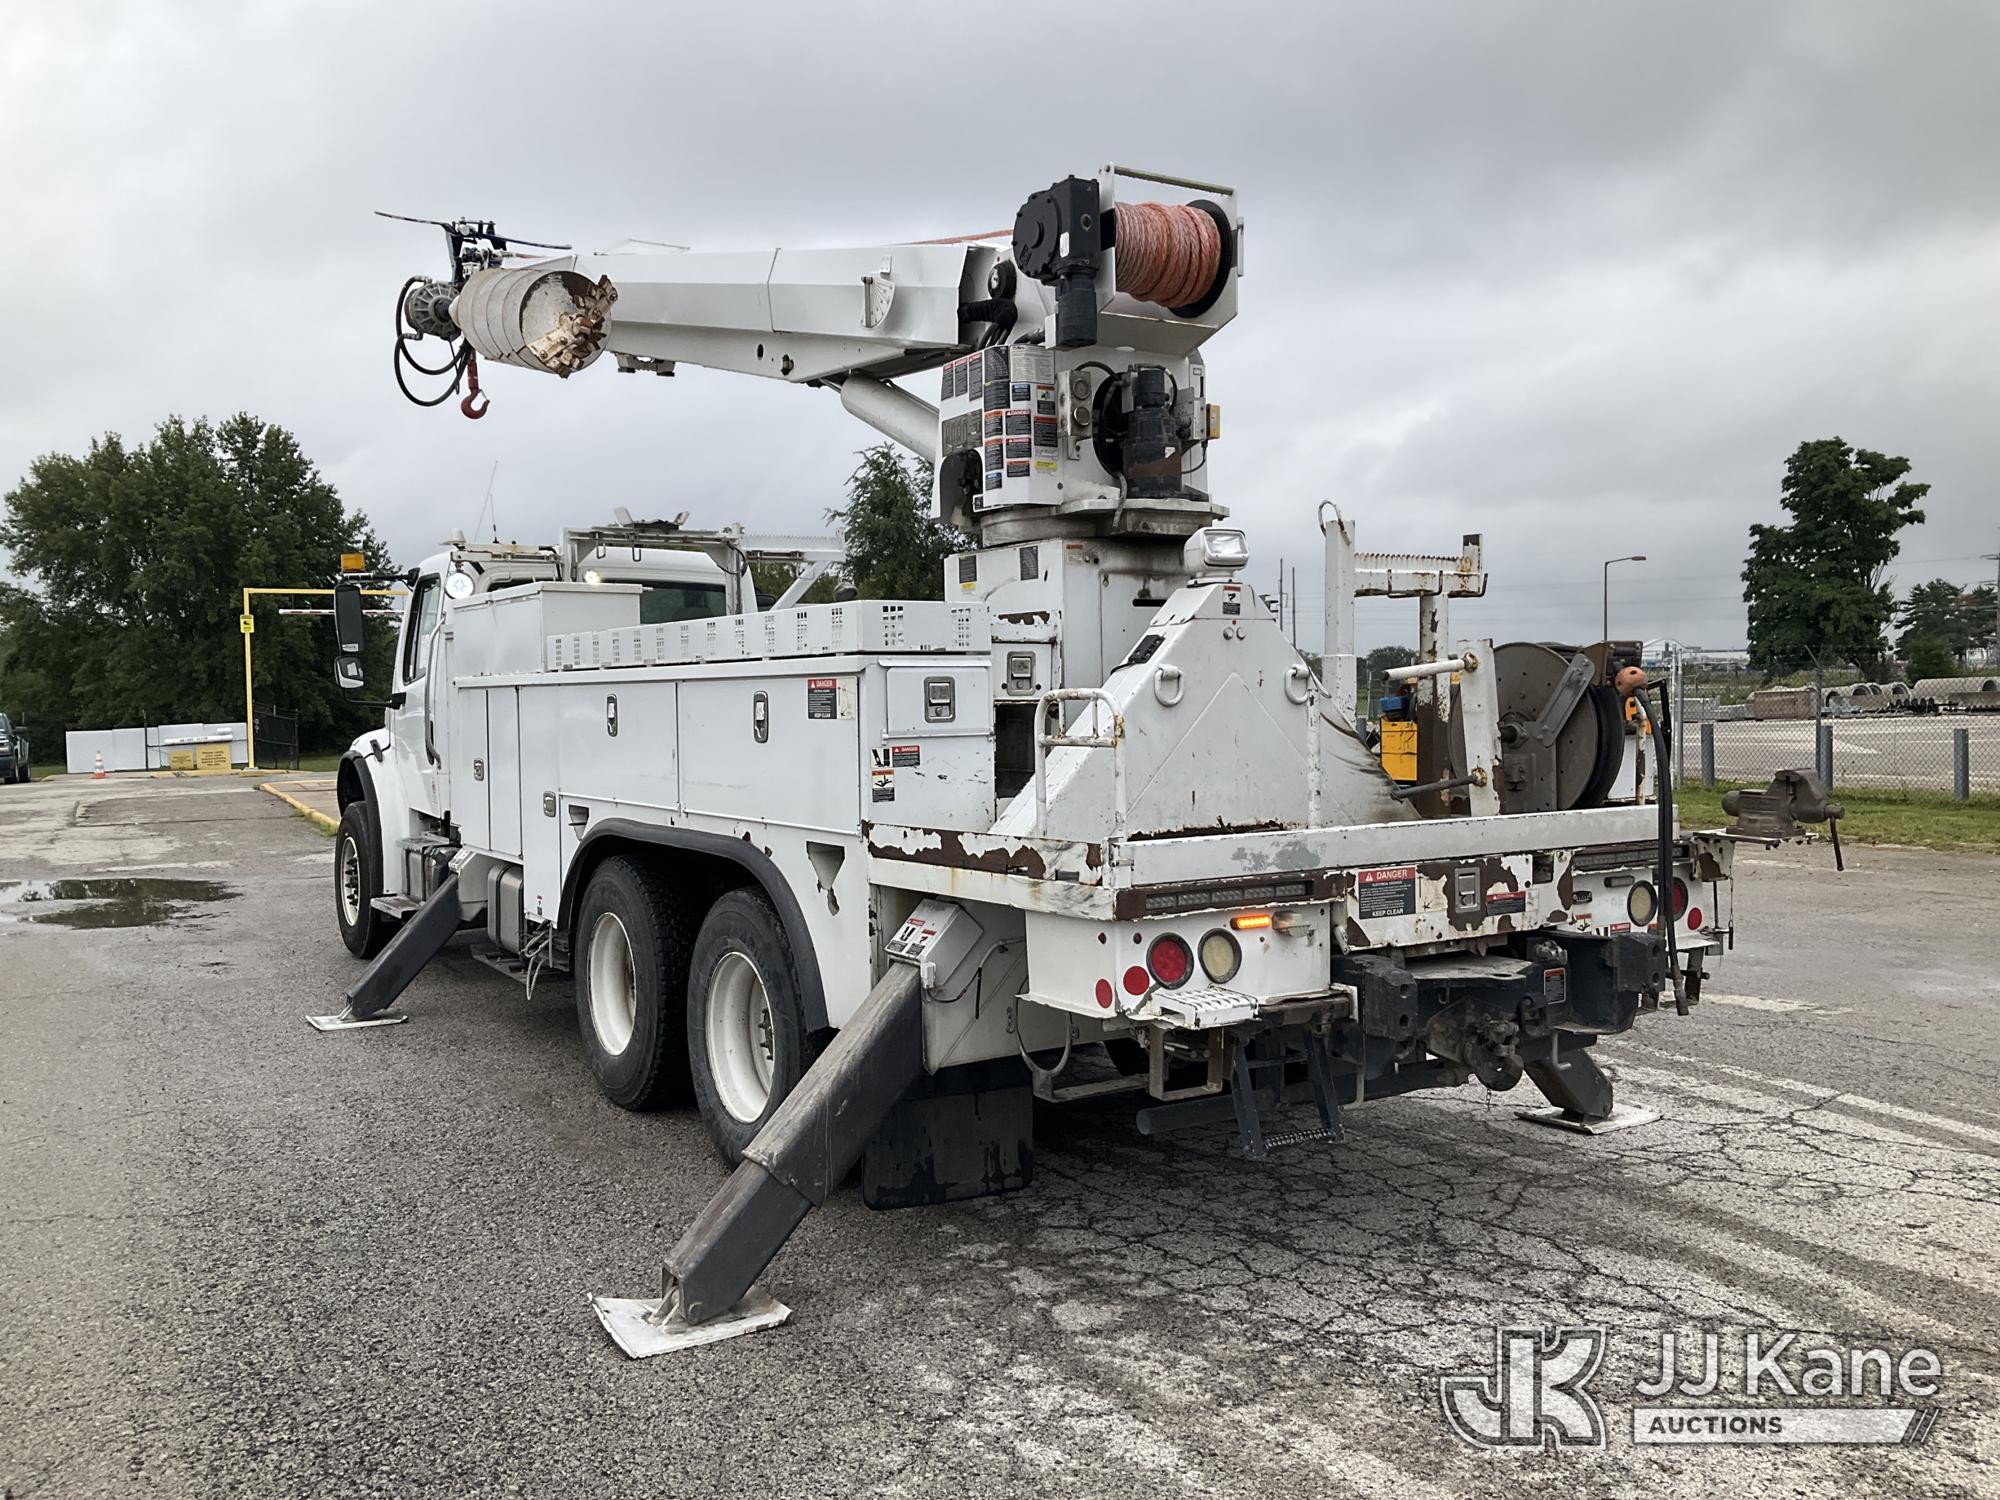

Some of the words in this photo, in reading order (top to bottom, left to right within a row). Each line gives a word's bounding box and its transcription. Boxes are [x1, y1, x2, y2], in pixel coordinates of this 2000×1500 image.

[816, 680, 833, 688] DANGER
[1376, 869, 1408, 879] DANGER
[1386, 908, 1404, 916] CLEAR
